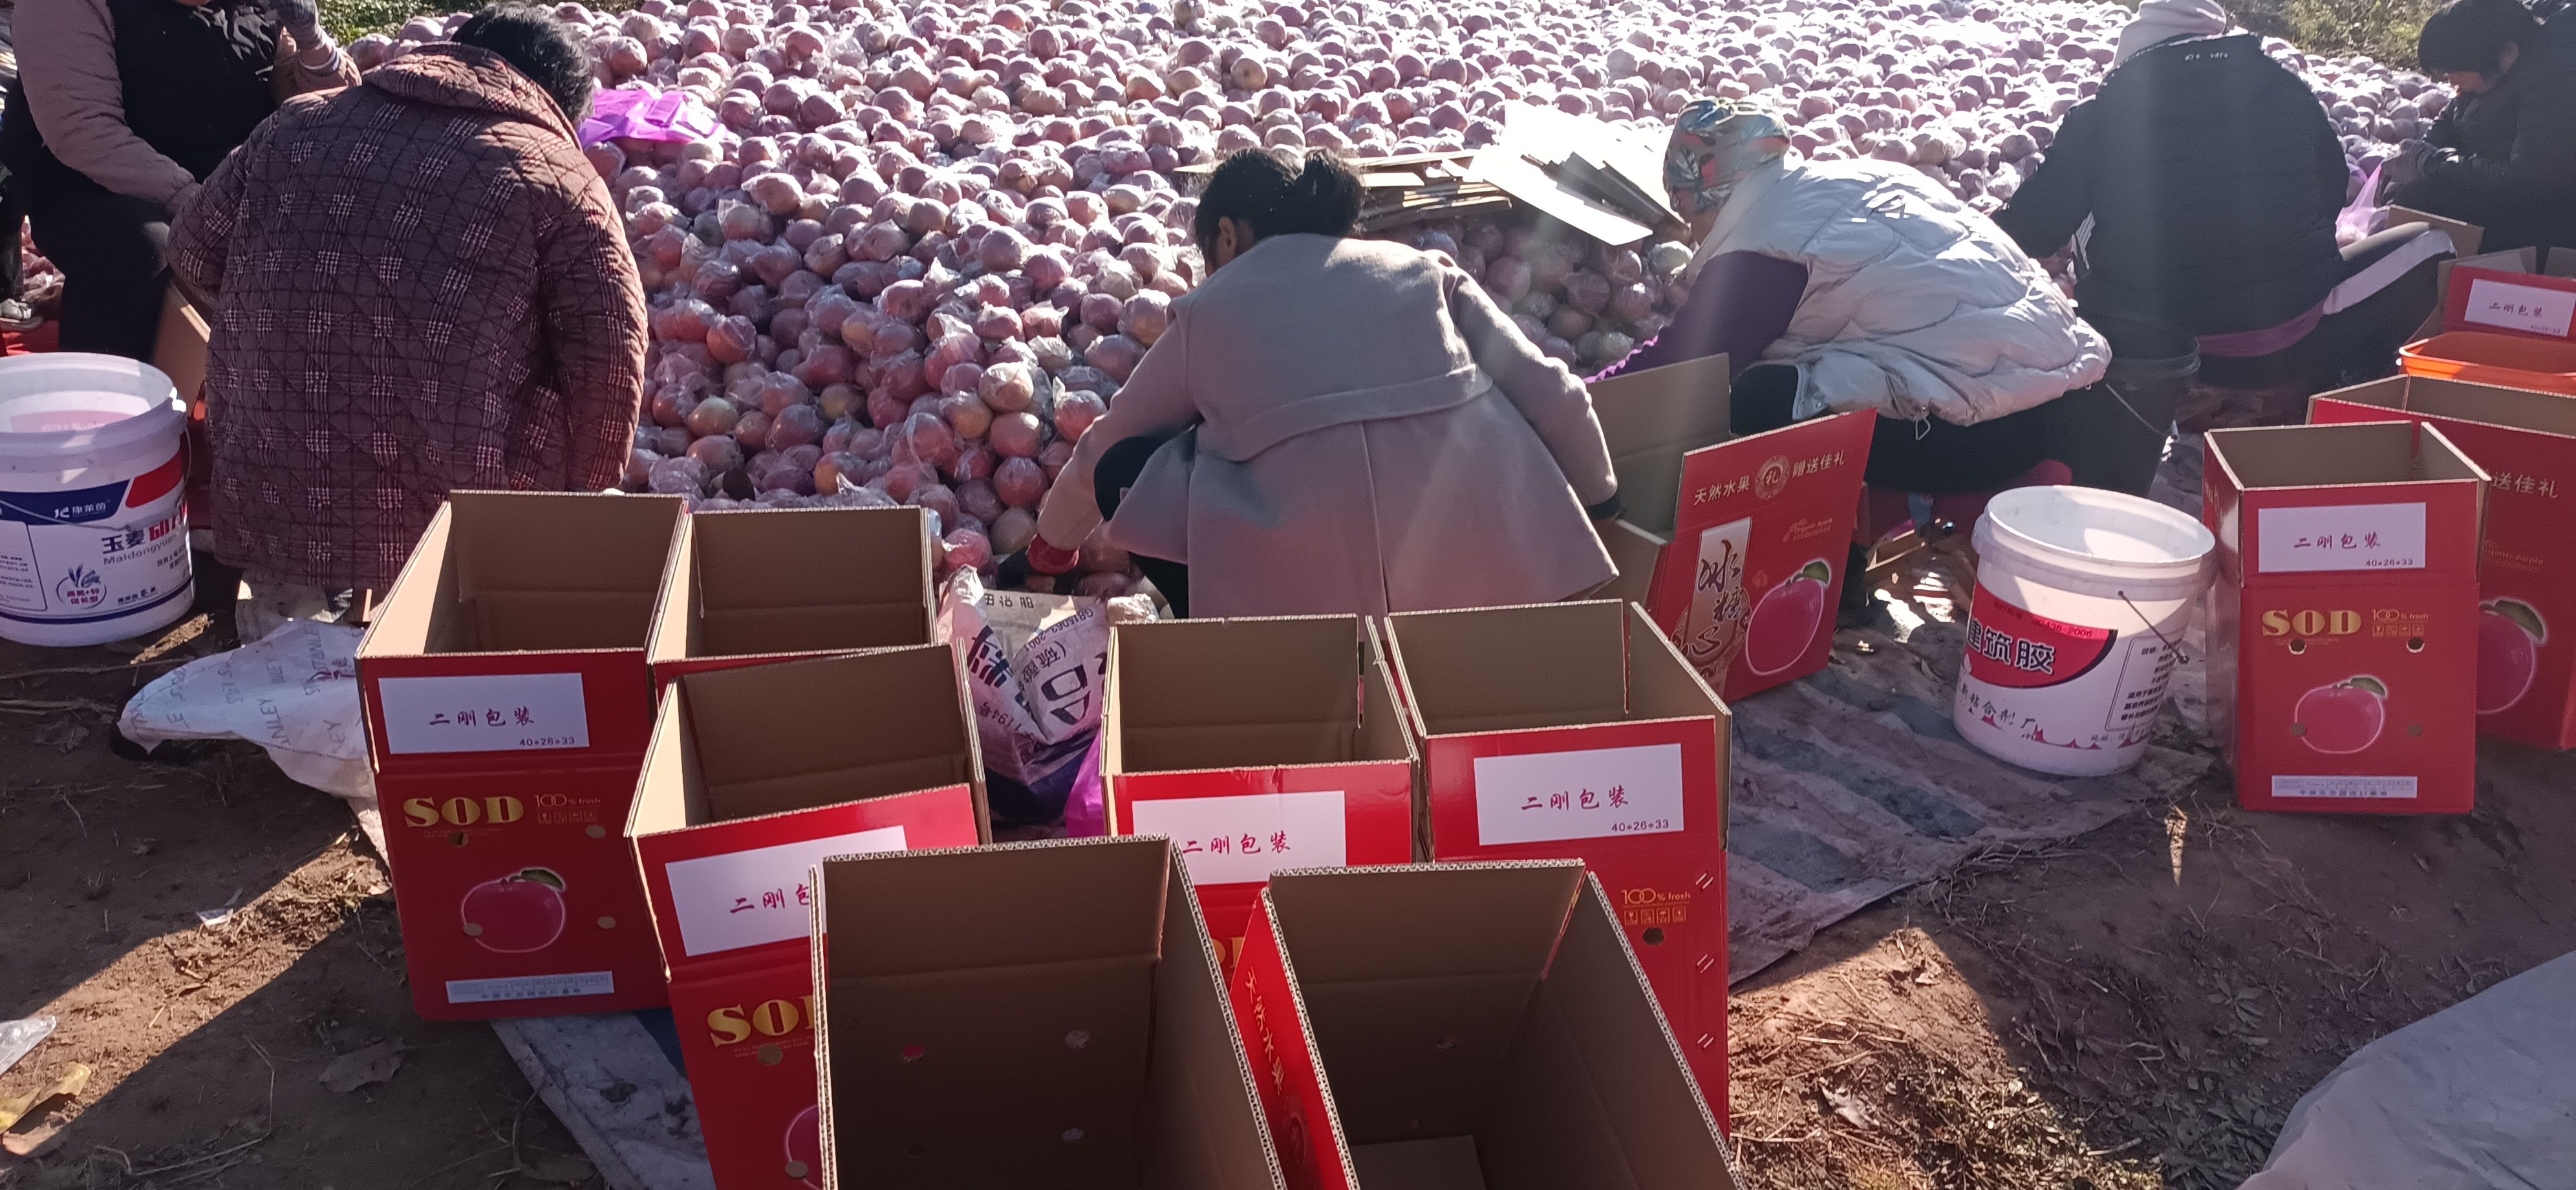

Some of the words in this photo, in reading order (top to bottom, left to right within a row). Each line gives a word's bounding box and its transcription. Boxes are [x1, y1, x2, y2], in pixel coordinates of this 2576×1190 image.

[1693, 469, 1750, 506] 天然水果
[1792, 450, 1845, 479] 赠送佳礼
[2489, 470, 2559, 499] 送佳礼
[2293, 531, 2380, 549] 二刚包装
[1691, 539, 1741, 656] 冰糖心
[2262, 609, 2362, 636] SOD
[1968, 618, 2054, 674] 建筑胶
[429, 706, 534, 727] 二刚包装
[403, 796, 524, 828] SOD
[1521, 784, 1628, 811] 二刚包装
[1182, 830, 1291, 855] 二刚包装
[1245, 966, 1285, 1096] 天然水果
